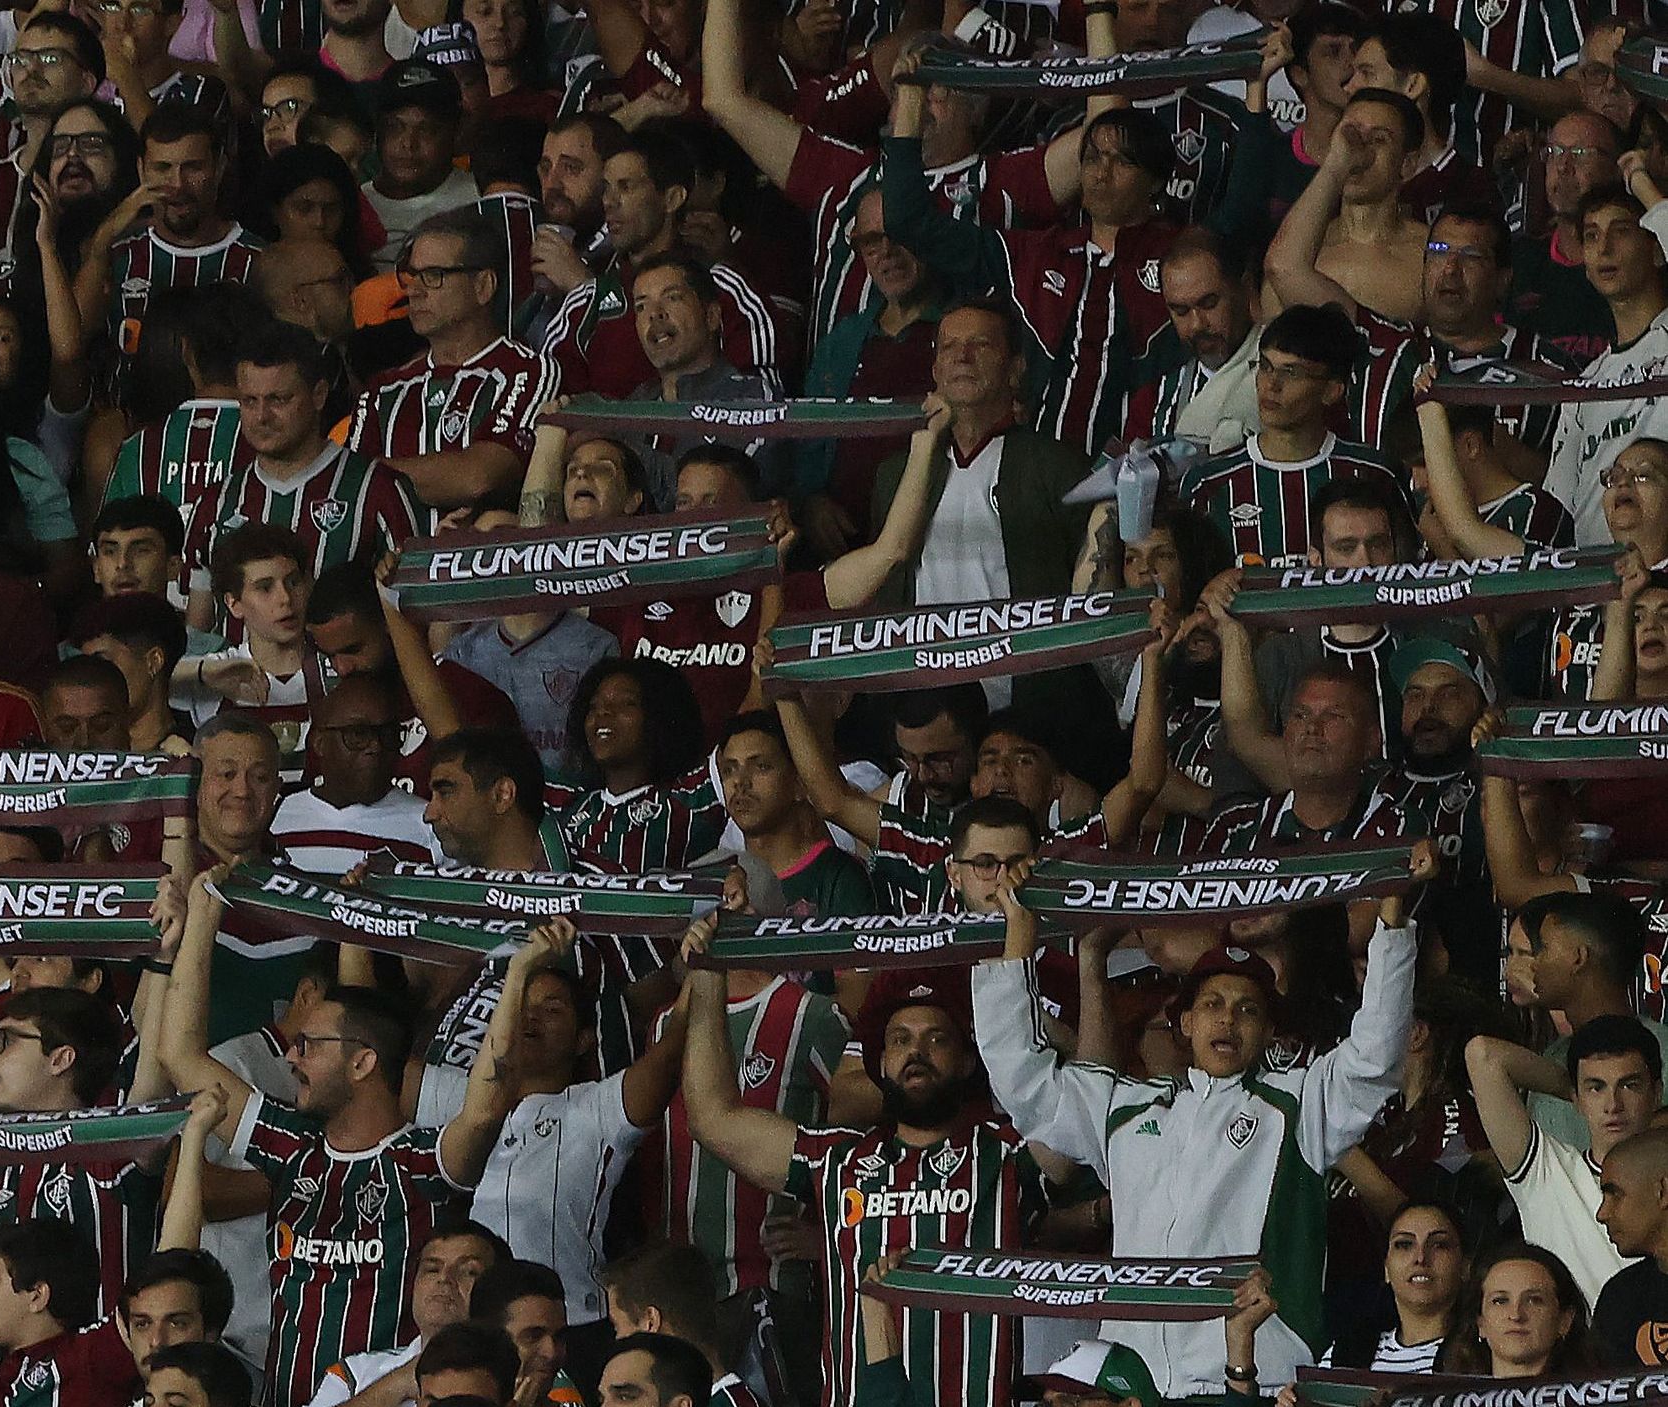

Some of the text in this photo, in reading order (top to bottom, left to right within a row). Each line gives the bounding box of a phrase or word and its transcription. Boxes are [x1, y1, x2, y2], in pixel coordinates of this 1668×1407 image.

[1038, 66, 1125, 89] SUPERBET
[690, 404, 788, 427] SUPERBET
[166, 458, 224, 485] PITTA
[428, 526, 729, 581] FLUMINENSE FC
[535, 571, 631, 597] SUPERBET
[1376, 579, 1472, 606] SUPERBET
[809, 593, 1114, 657] FLUMINENSE FC
[914, 638, 1012, 668] SUPERBET
[1179, 858, 1280, 873] SUPERBET
[74, 885, 124, 915] FC
[486, 889, 582, 914] SUPERBET
[1065, 871, 1371, 910] FLUMINENSE FC
[330, 905, 418, 935] SUPERBET
[853, 928, 956, 954] SUPERBET
[865, 1189, 969, 1219] BETANO
[294, 1237, 384, 1264] BETANO
[933, 1254, 1222, 1288] FLUMINENSE FC
[1013, 1285, 1107, 1305] SUPERBET
